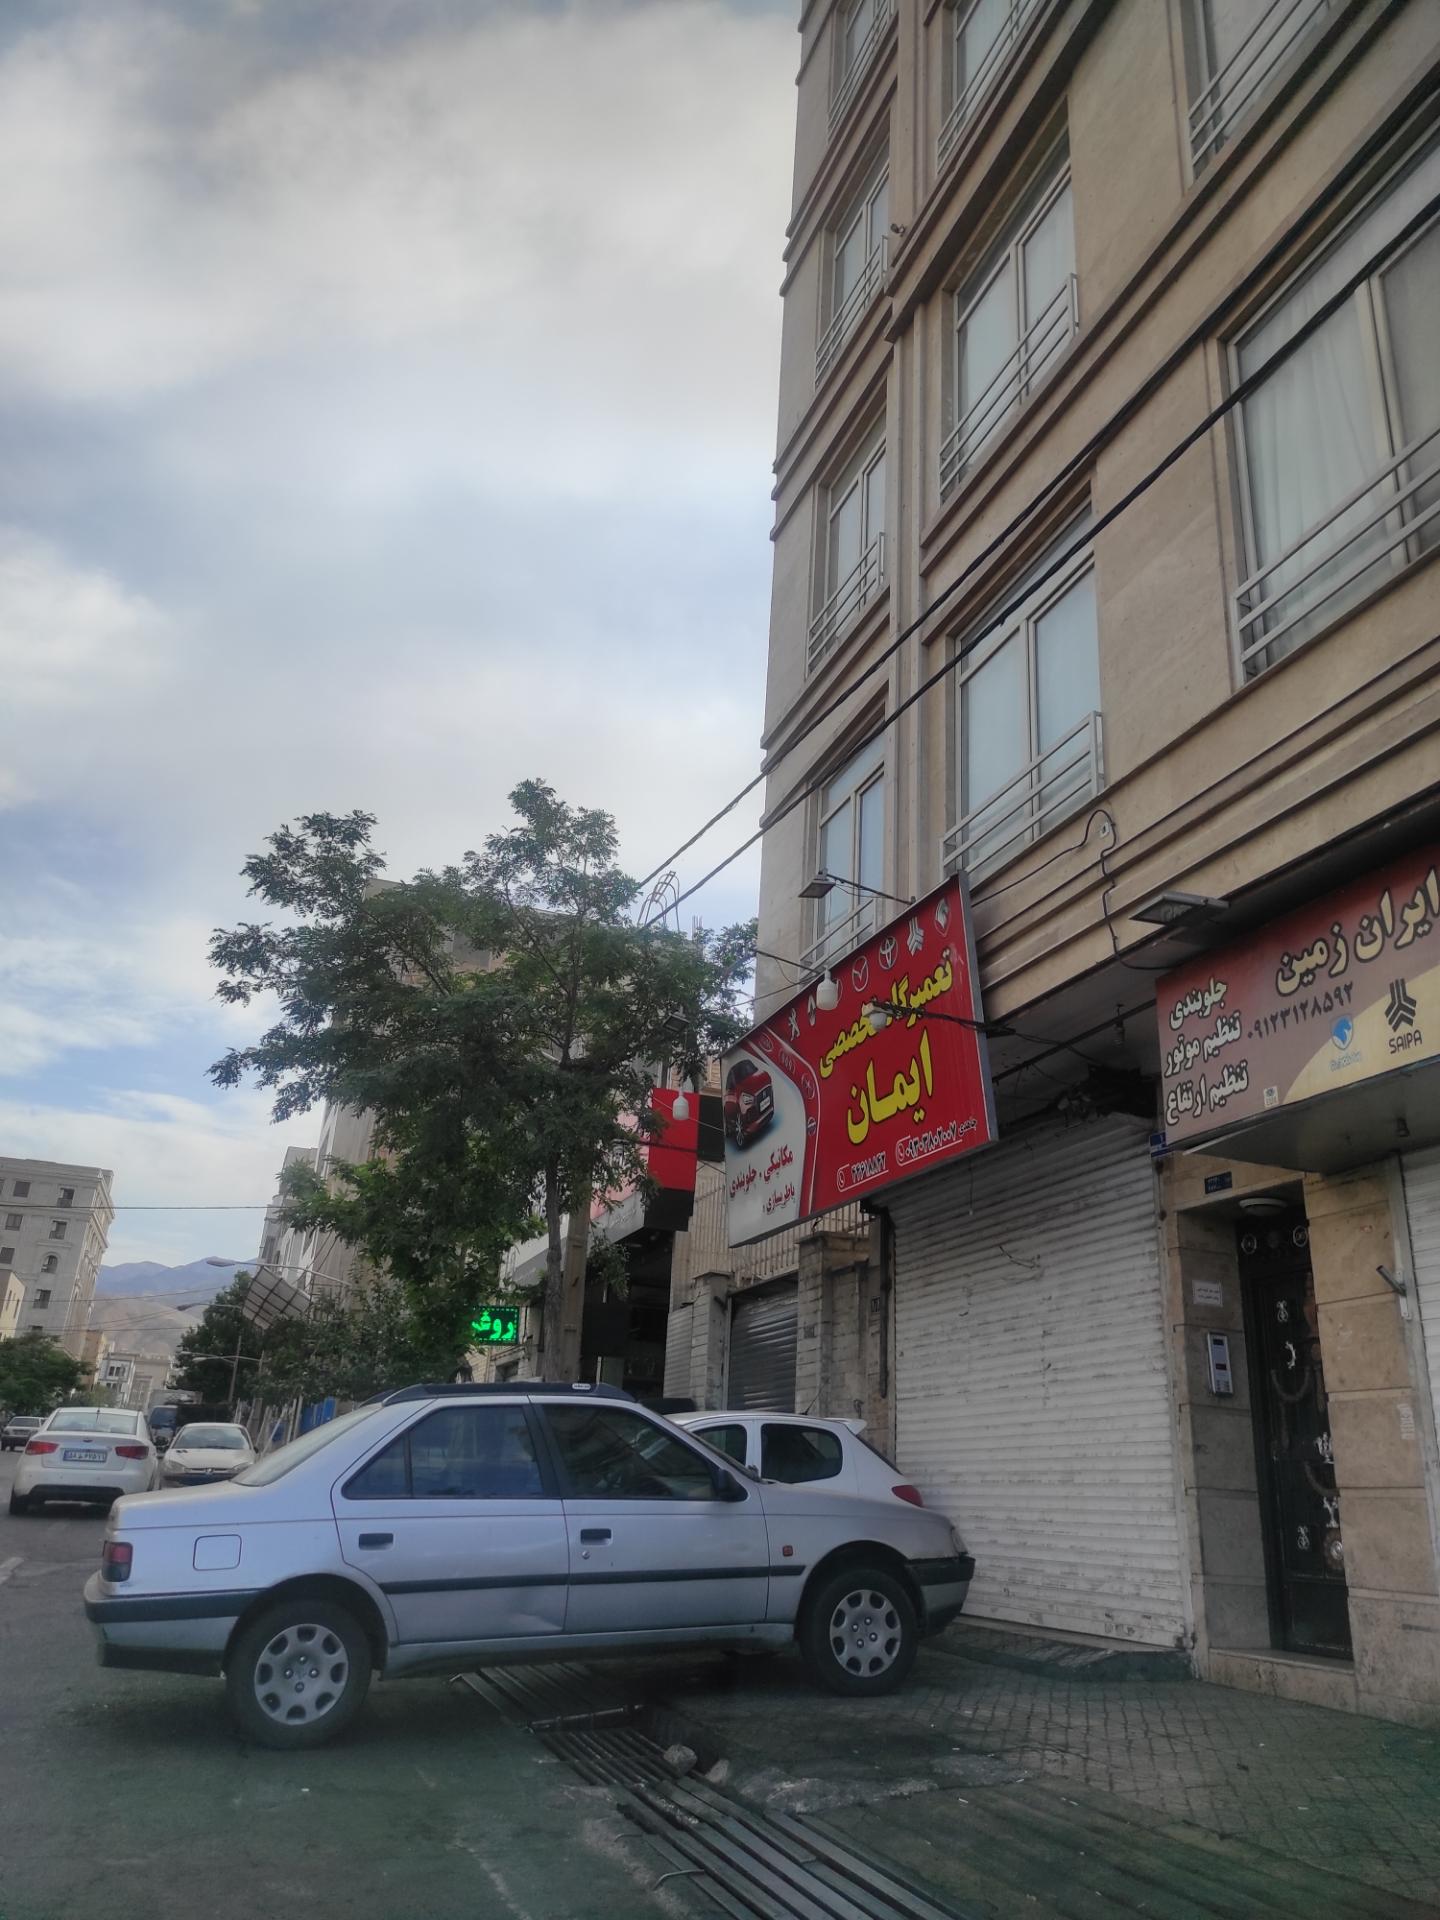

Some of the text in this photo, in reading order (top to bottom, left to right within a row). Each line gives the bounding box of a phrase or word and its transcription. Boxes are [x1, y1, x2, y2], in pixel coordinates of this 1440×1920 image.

[1275, 866, 1440, 997] ایران زمین
[1168, 977, 1228, 1030] جلوبندی
[1247, 981, 1354, 1039] ۰۹۱۲۳۱۲۸۵۹۲
[1164, 1010, 1242, 1078] تنظیم موتور
[1388, 1029, 1423, 1055] SAIPA
[846, 1027, 935, 1145] ایمان
[1164, 1059, 1250, 1126] تنظیم ارتفاع
